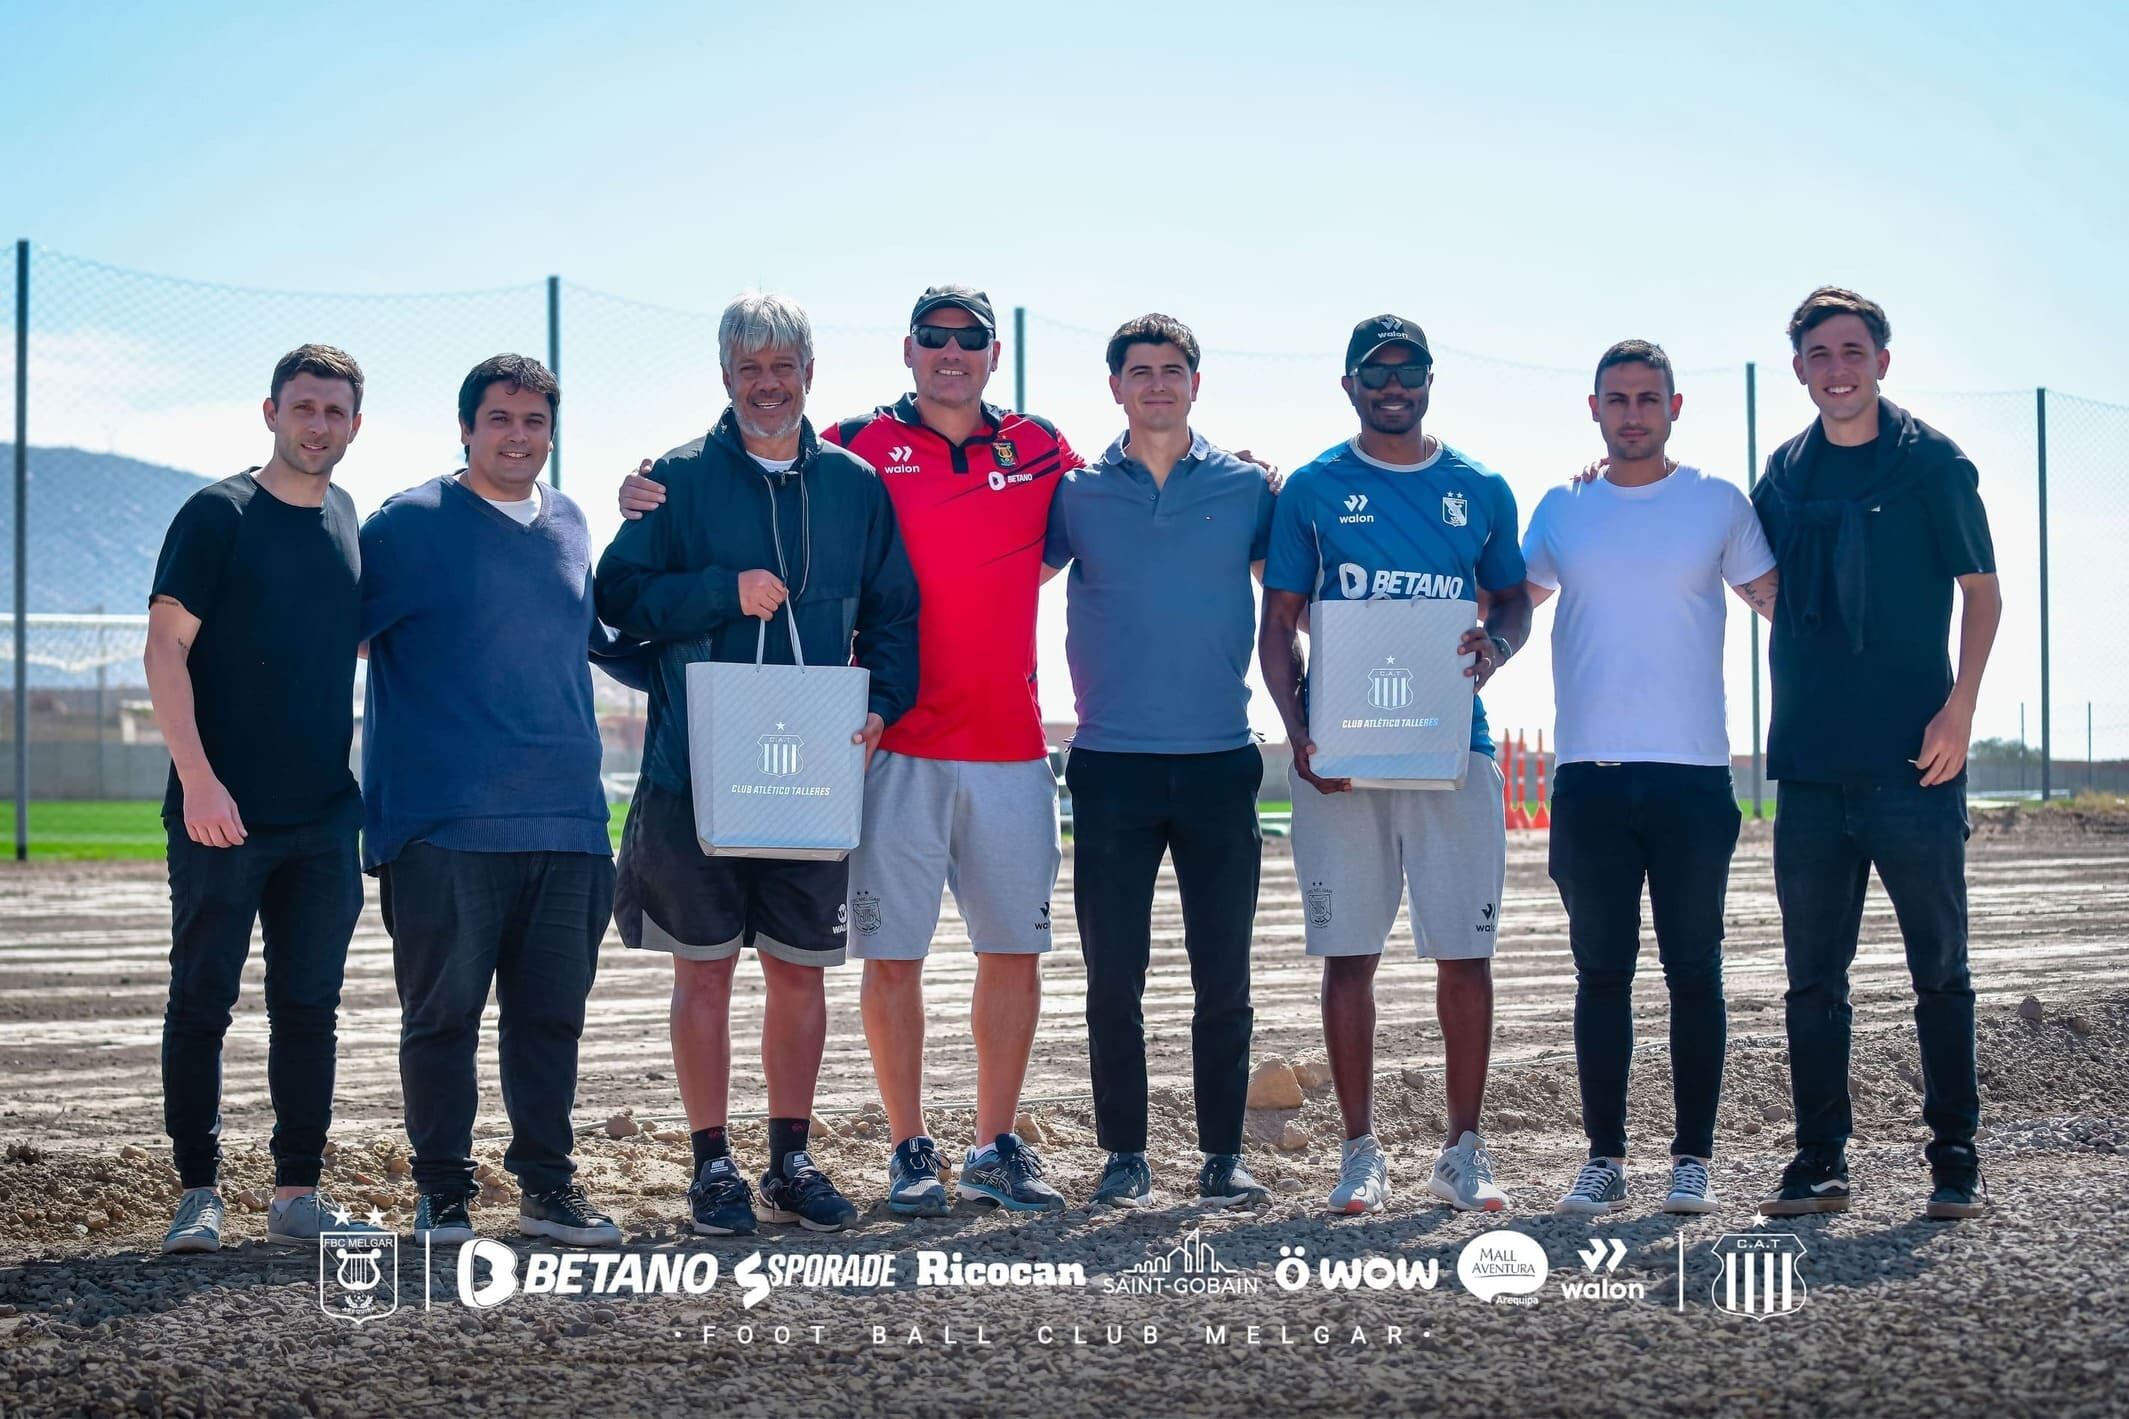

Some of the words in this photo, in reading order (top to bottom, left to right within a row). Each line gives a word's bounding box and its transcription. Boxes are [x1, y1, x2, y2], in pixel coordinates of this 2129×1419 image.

[885, 464, 920, 474] walon
[1007, 473, 1033, 483] BETANO
[1339, 513, 1374, 524] walon
[1372, 570, 1463, 600] BETANO
[1342, 719, 1362, 728] CLUB
[1363, 717, 1400, 728] ATLÉTICO
[1401, 718, 1439, 727] TALLERES
[731, 784, 752, 793] CLUB
[753, 784, 790, 795] ATLÉTICO
[791, 786, 831, 796] TALLERES
